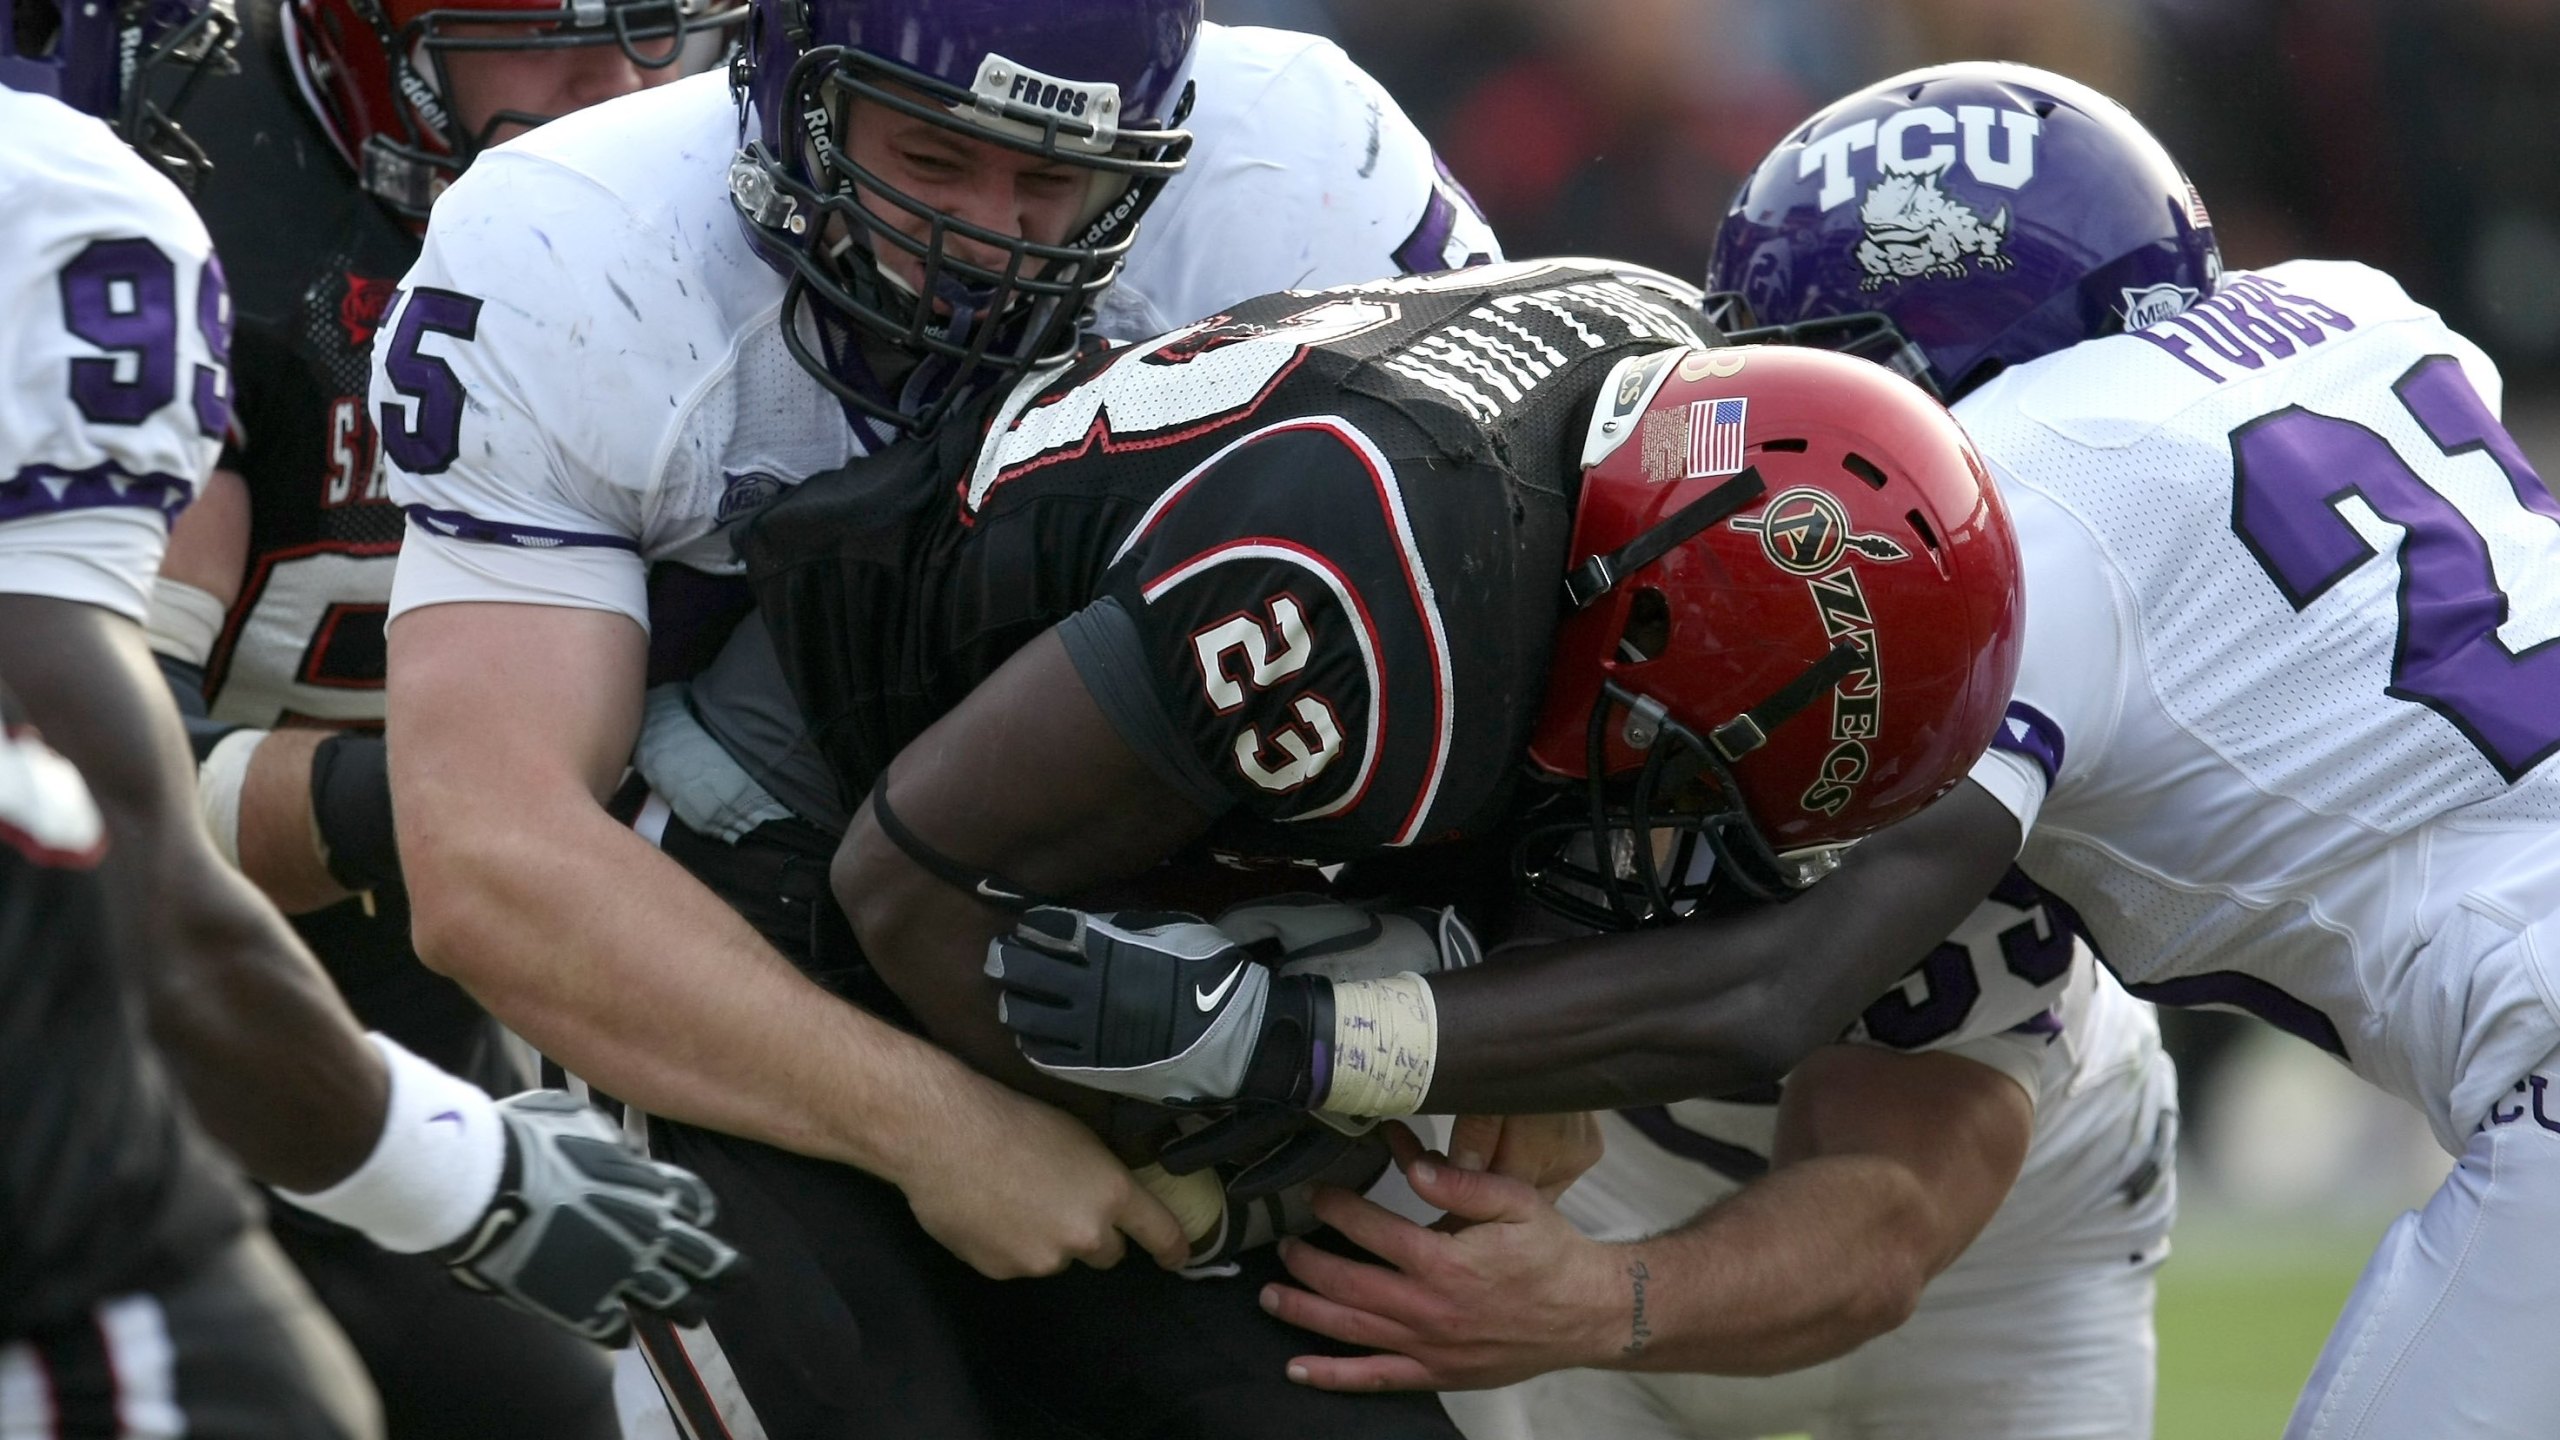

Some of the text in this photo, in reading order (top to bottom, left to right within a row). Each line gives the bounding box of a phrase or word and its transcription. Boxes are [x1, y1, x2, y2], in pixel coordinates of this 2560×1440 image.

[1008, 73, 1089, 117] FROGS
[1799, 104, 2041, 210] TCU
[1188, 591, 1346, 795] 23
